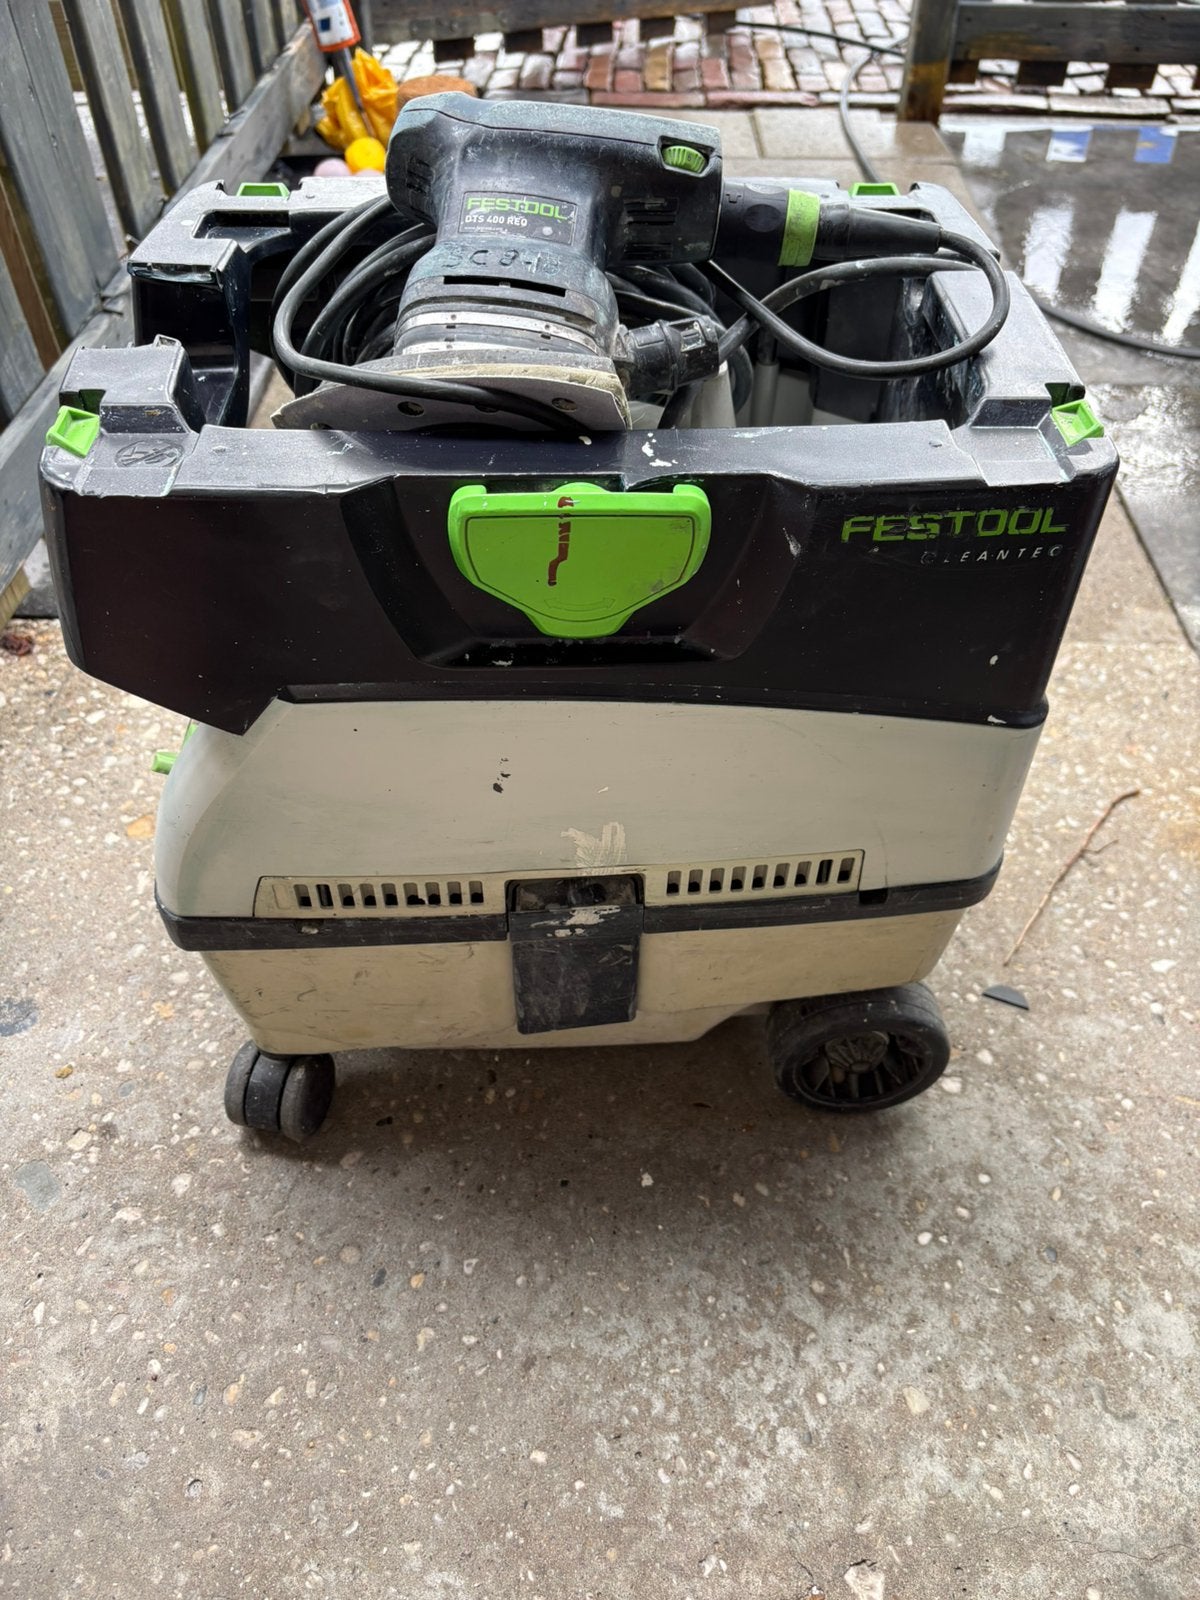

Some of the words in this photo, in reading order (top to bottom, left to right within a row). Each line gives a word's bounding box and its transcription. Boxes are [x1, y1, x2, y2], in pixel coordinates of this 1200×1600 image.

[464, 214, 485, 223] DTS
[486, 215, 505, 224] 400
[466, 197, 568, 220] FESTOOL
[841, 507, 1070, 543] FESTOOL
